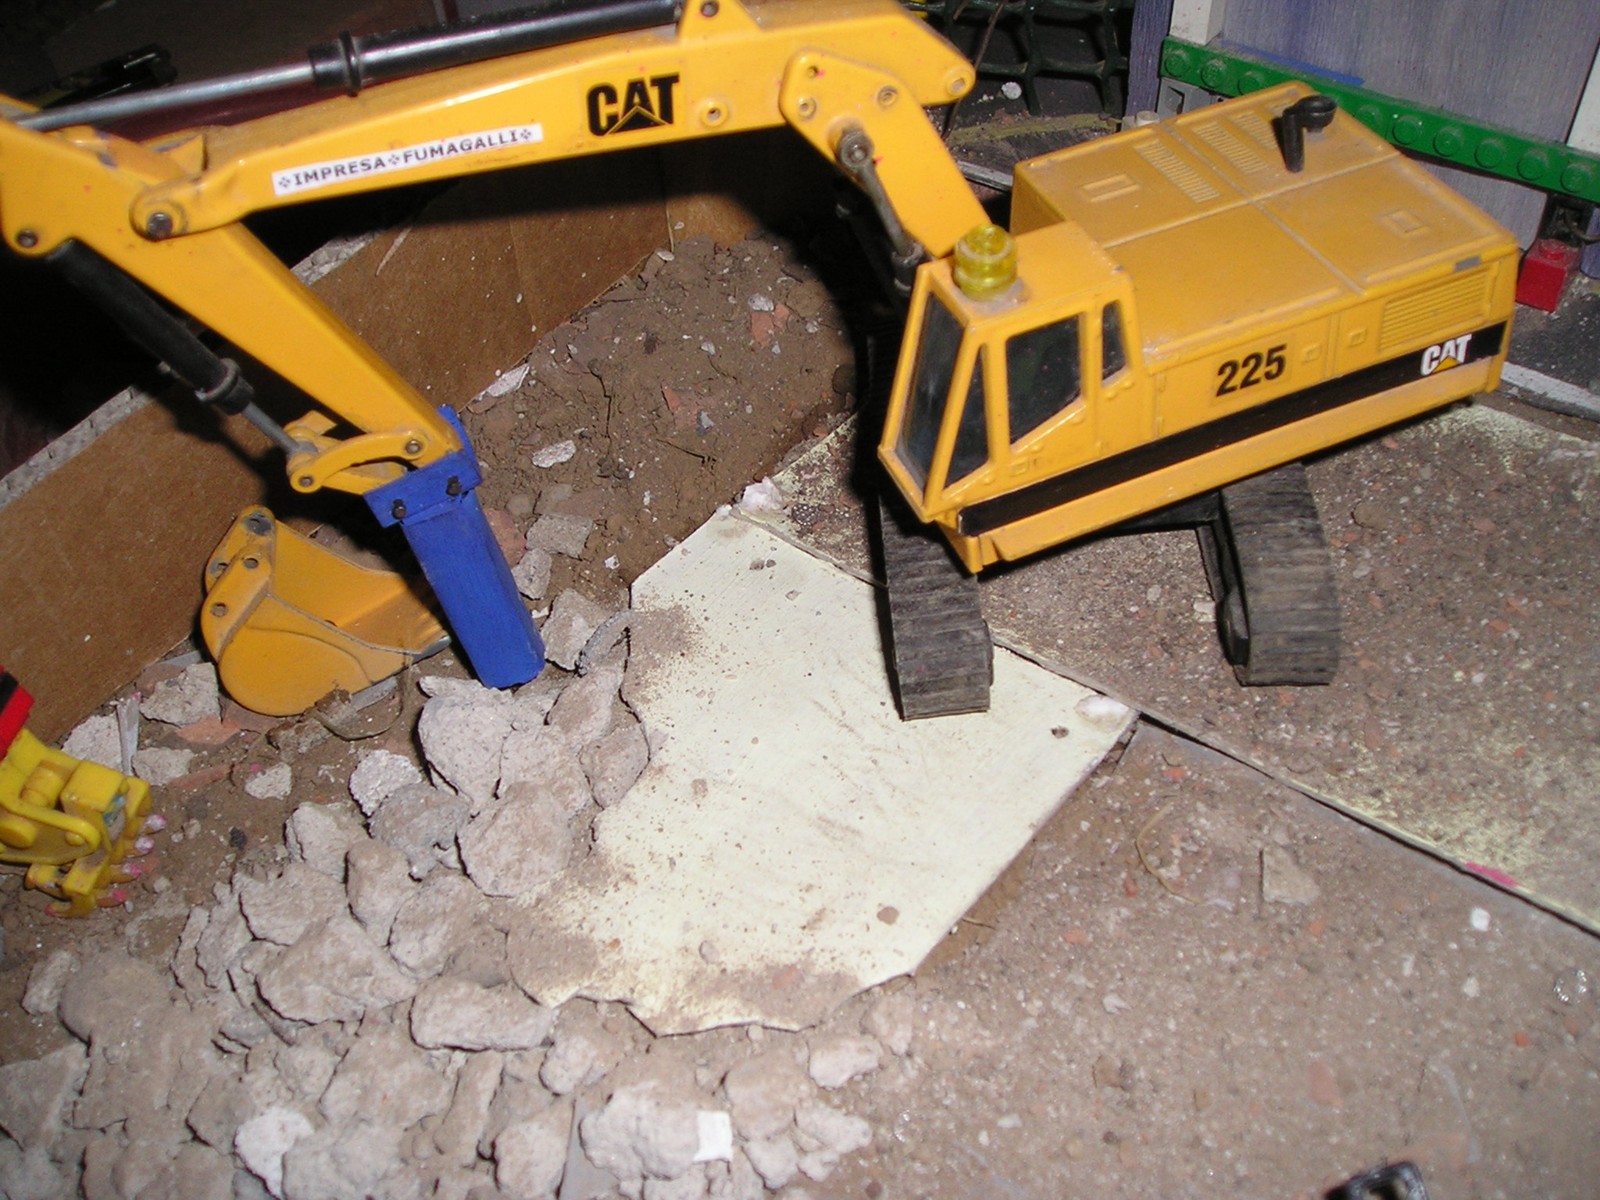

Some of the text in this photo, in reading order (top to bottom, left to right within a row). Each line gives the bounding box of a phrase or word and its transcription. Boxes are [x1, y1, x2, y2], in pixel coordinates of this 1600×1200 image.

[587, 72, 680, 137] CAT
[293, 129, 519, 187] IMPRESA FUMAGALLI
[1216, 343, 1287, 397] 225
[1420, 333, 1472, 377] CAT
